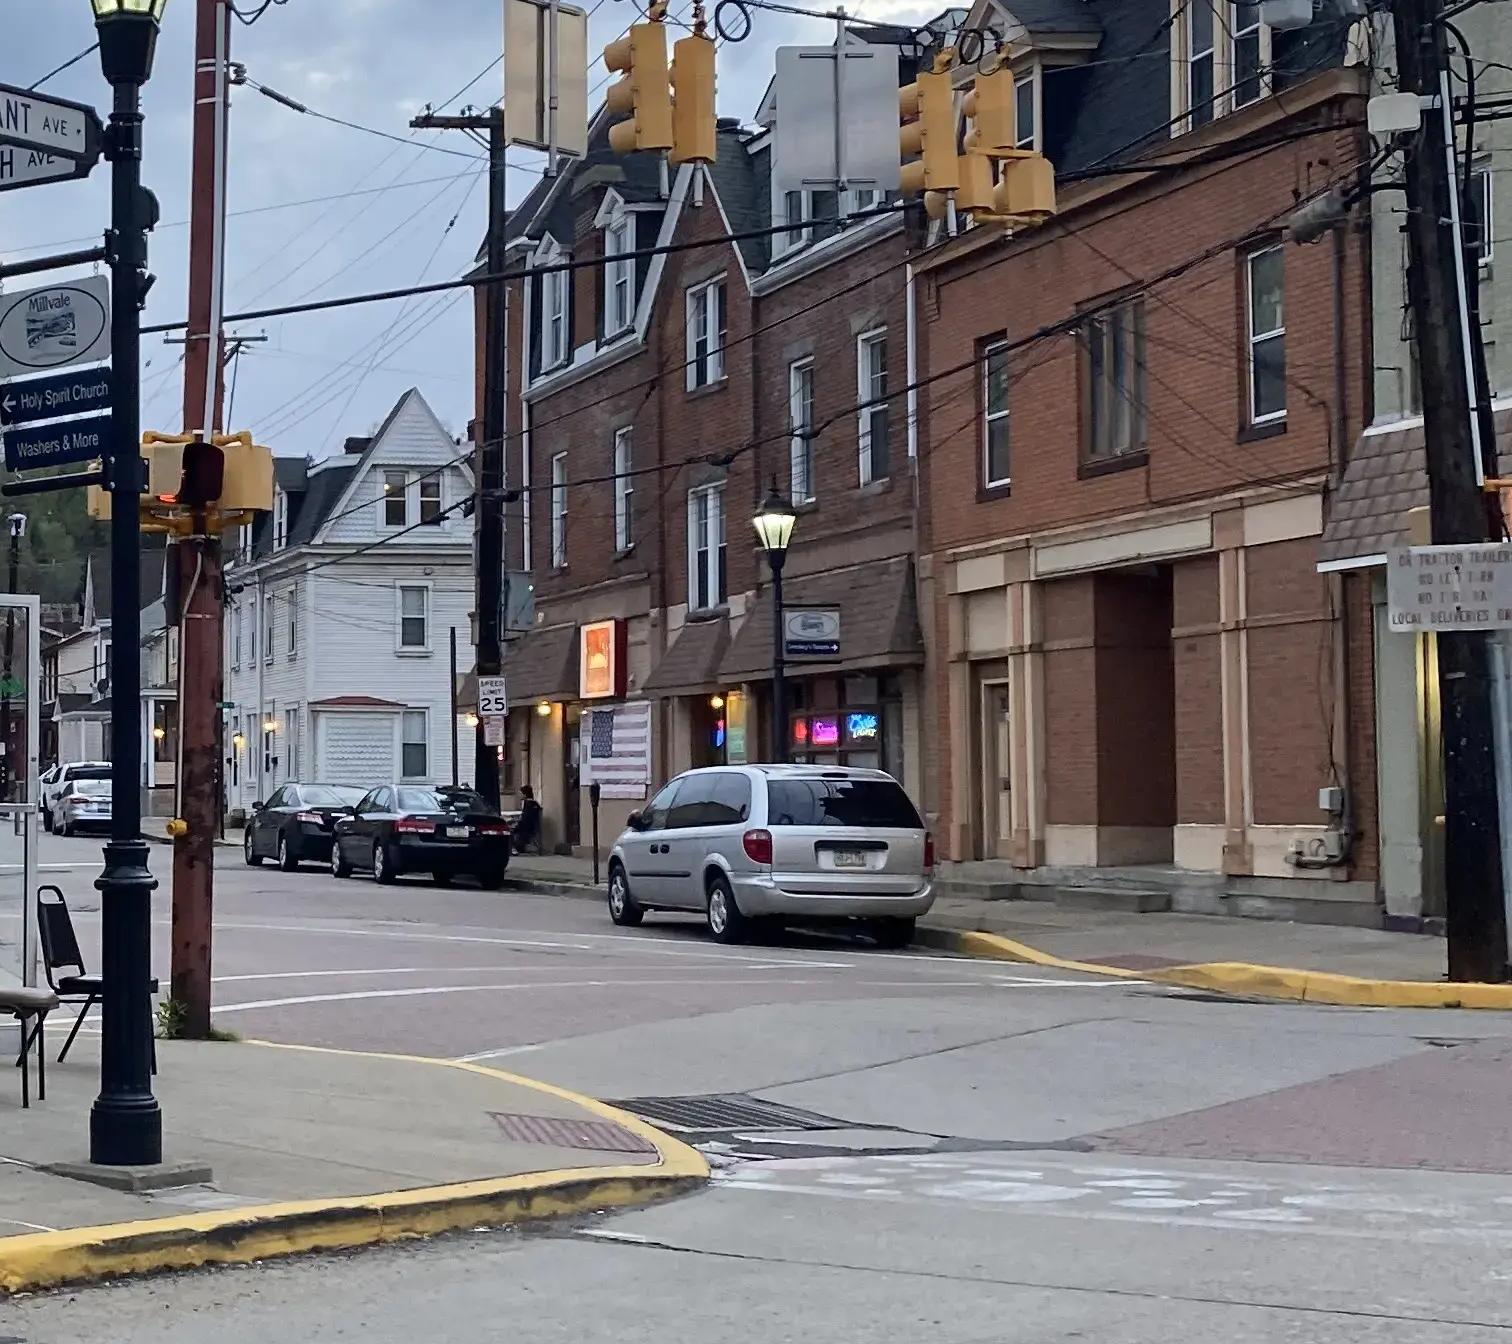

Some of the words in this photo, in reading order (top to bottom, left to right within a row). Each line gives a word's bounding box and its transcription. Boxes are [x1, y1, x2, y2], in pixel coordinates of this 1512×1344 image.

[42, 116, 68, 136] AVE
[27, 152, 56, 168] AVE
[28, 292, 71, 313] Millvale
[20, 393, 43, 411] Holy
[45, 388, 70, 407] Spirit
[72, 382, 109, 402] Church
[16, 438, 60, 458] Washers
[62, 434, 71, 451] &
[72, 432, 99, 449] More
[1439, 571, 1462, 584] LET
[1468, 570, 1494, 583] TRN
[1392, 612, 1422, 625] LOCAL
[1430, 609, 1489, 624] DELIVERIES
[482, 688, 502, 696] LIMIT
[481, 697, 505, 711] 25
